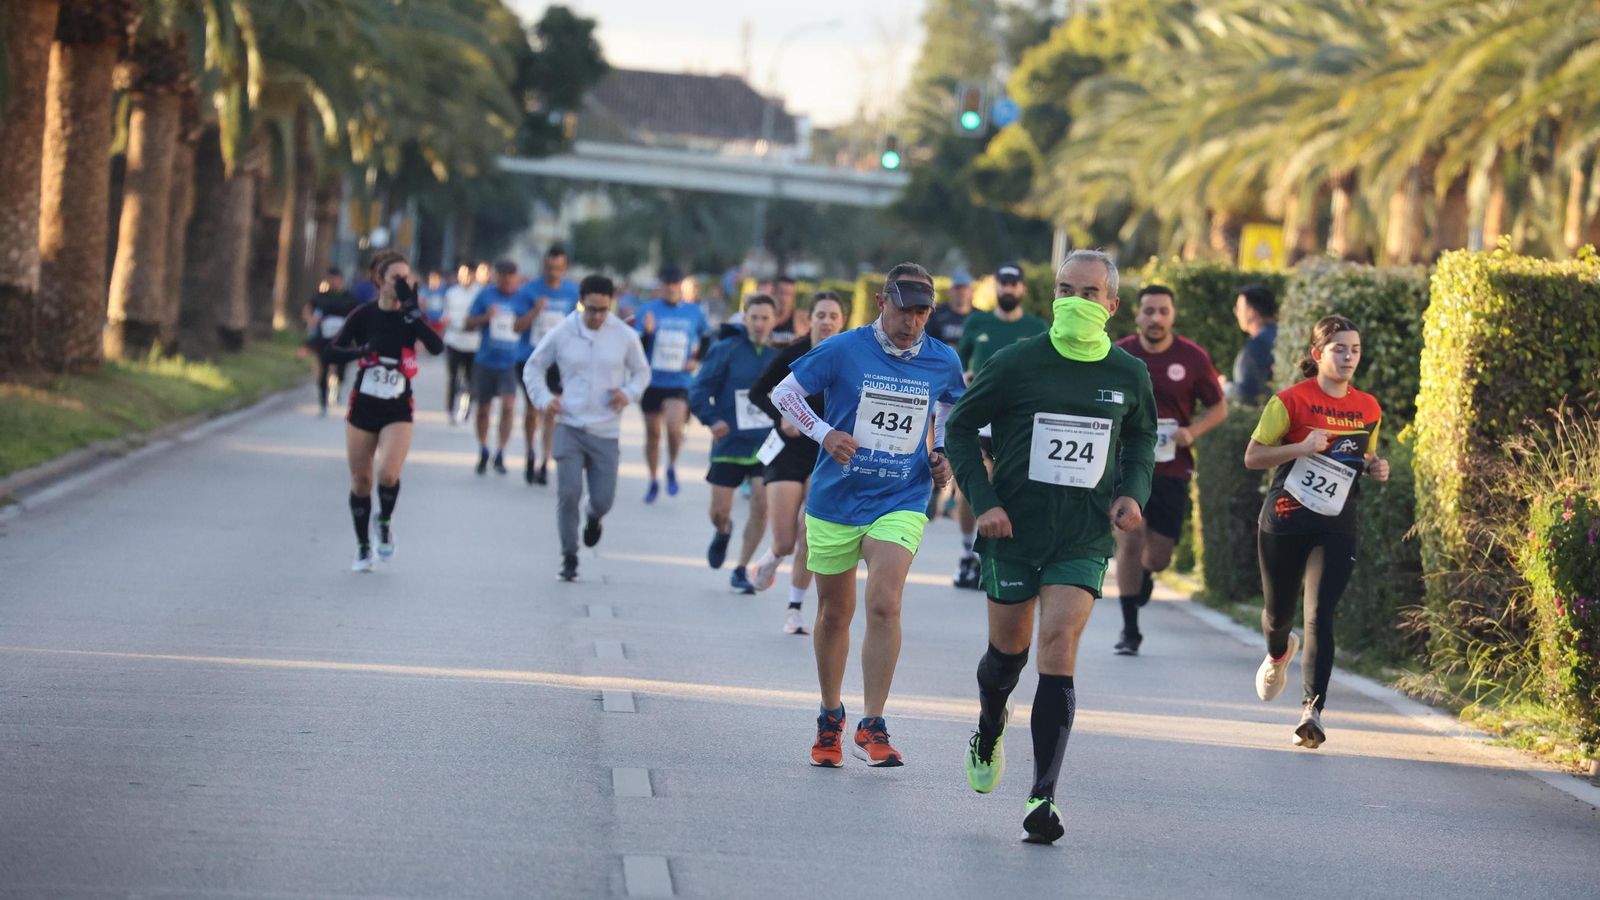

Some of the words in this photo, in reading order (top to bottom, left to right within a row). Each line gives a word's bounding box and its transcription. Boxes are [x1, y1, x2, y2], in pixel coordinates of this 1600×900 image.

[373, 369, 399, 386] 530
[872, 374, 899, 382] CARRERA
[899, 378, 922, 386] URBANA
[862, 380, 897, 391] CIUDAD
[898, 385, 930, 396] JARDÍN
[1311, 405, 1363, 420] Málaga
[871, 411, 912, 434] 434
[1326, 416, 1365, 428] Bahía
[1048, 439, 1094, 463] 224
[1301, 470, 1338, 499] 324
